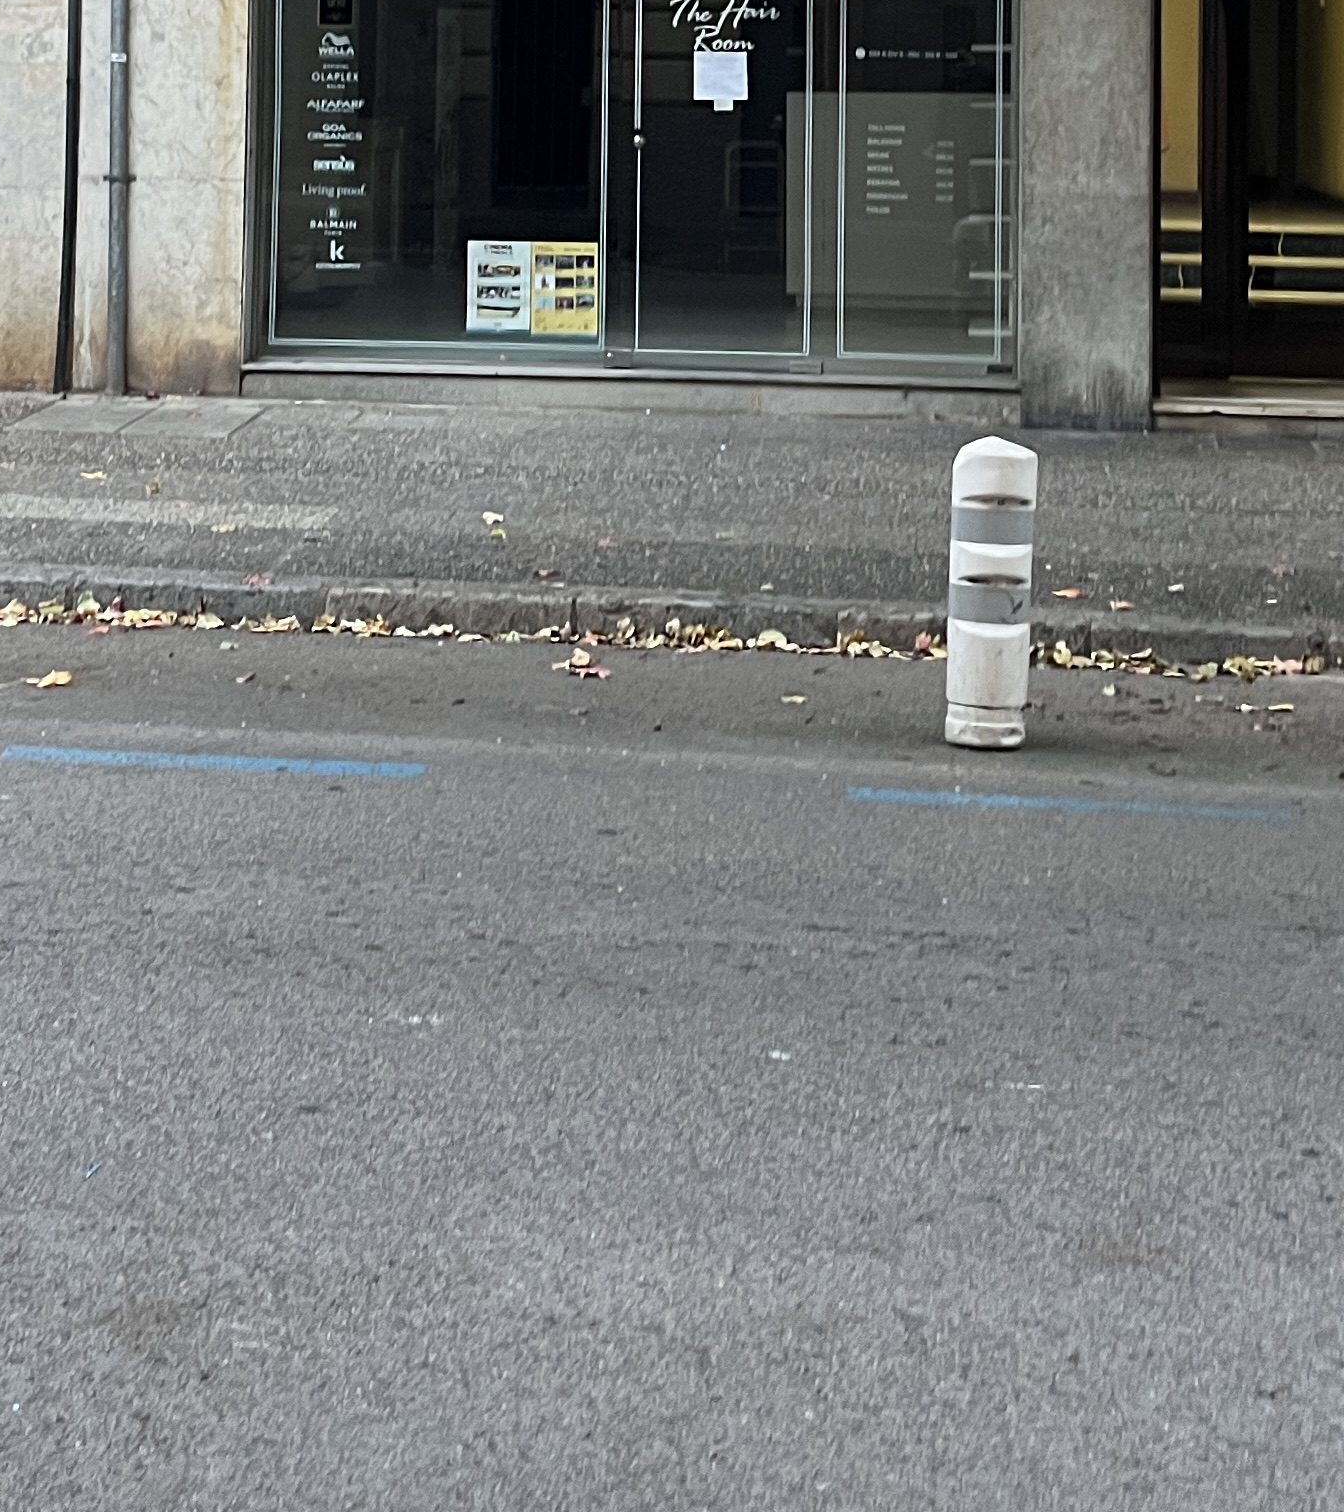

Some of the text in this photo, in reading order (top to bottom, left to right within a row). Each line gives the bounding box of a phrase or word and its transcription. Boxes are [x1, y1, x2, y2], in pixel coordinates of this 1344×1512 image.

[693, 25, 755, 55] Room
[318, 46, 355, 57] WELLA
[311, 71, 359, 83] OLAPLEX
[302, 183, 335, 198] Living
[309, 219, 357, 230] BALMAIN
[330, 240, 344, 261] k
